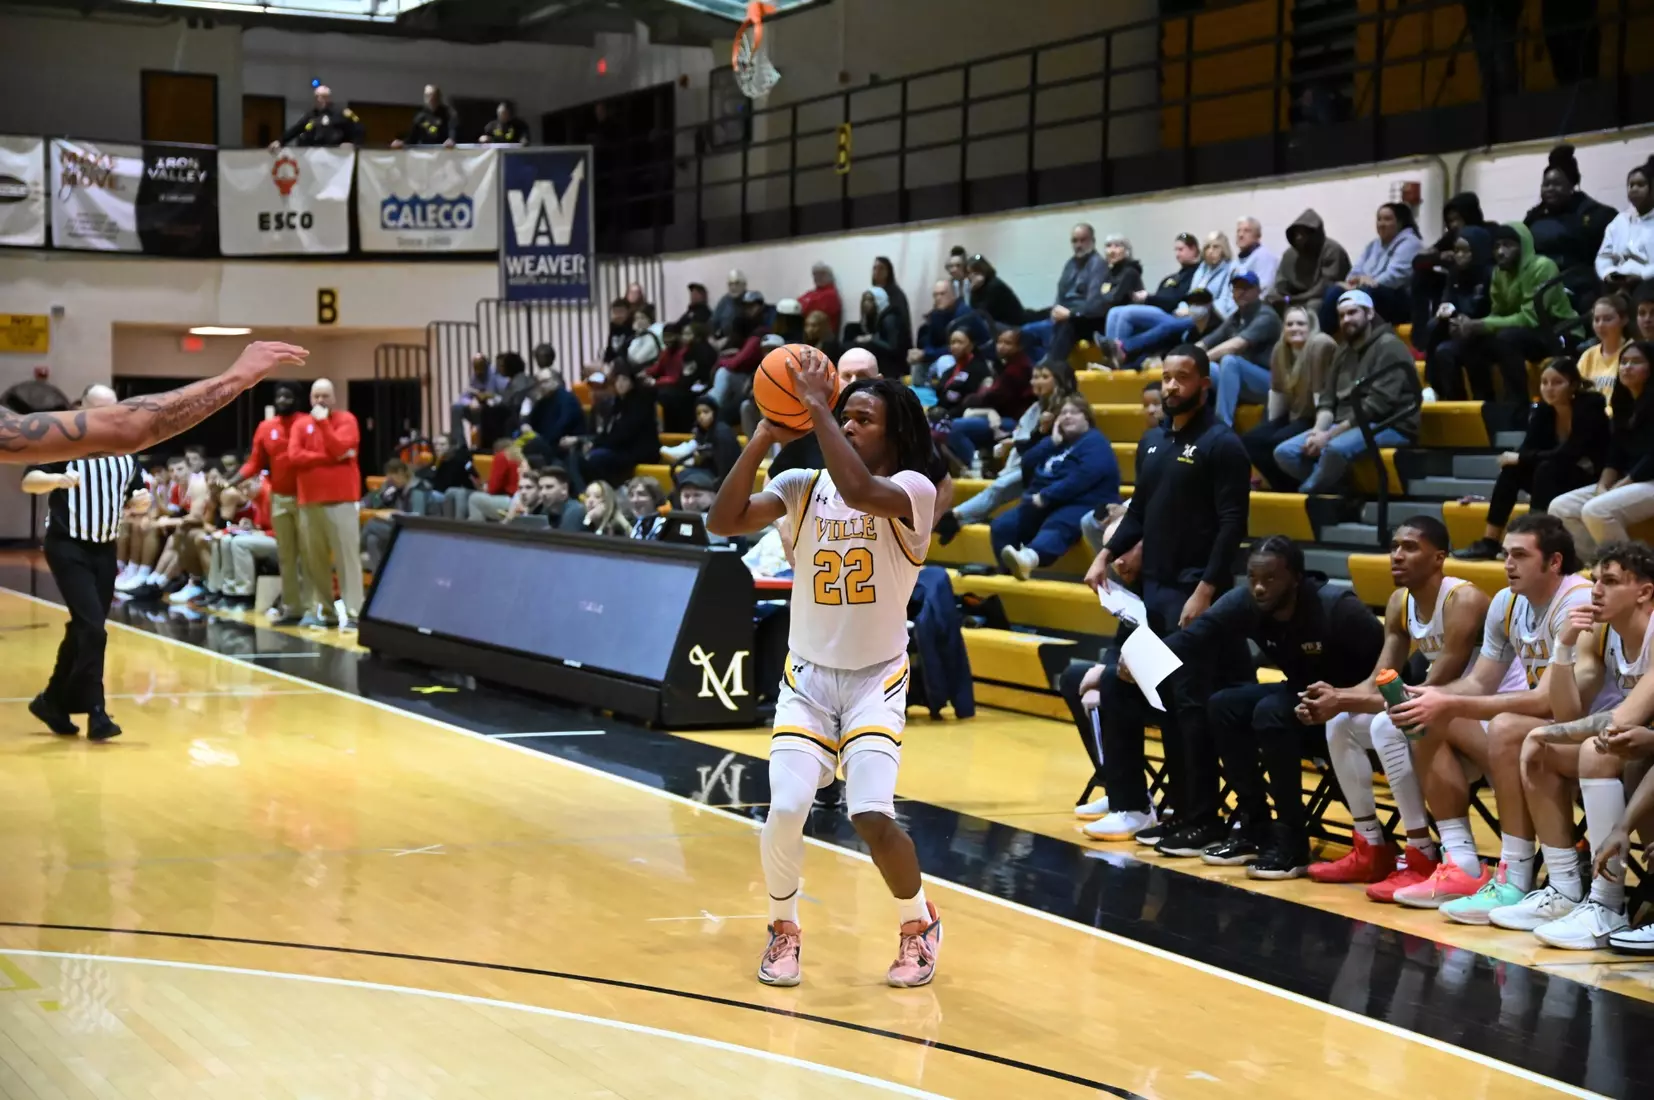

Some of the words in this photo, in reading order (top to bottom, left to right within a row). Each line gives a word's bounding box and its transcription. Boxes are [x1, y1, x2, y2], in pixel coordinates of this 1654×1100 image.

[147, 168, 208, 183] VALLEY
[258, 211, 315, 232] ESCO
[383, 203, 471, 228] CALECO
[505, 254, 586, 276] WEAVER
[317, 288, 338, 324] B
[815, 514, 877, 542] VILLE
[813, 546, 876, 606] 22
[689, 644, 750, 710] M
